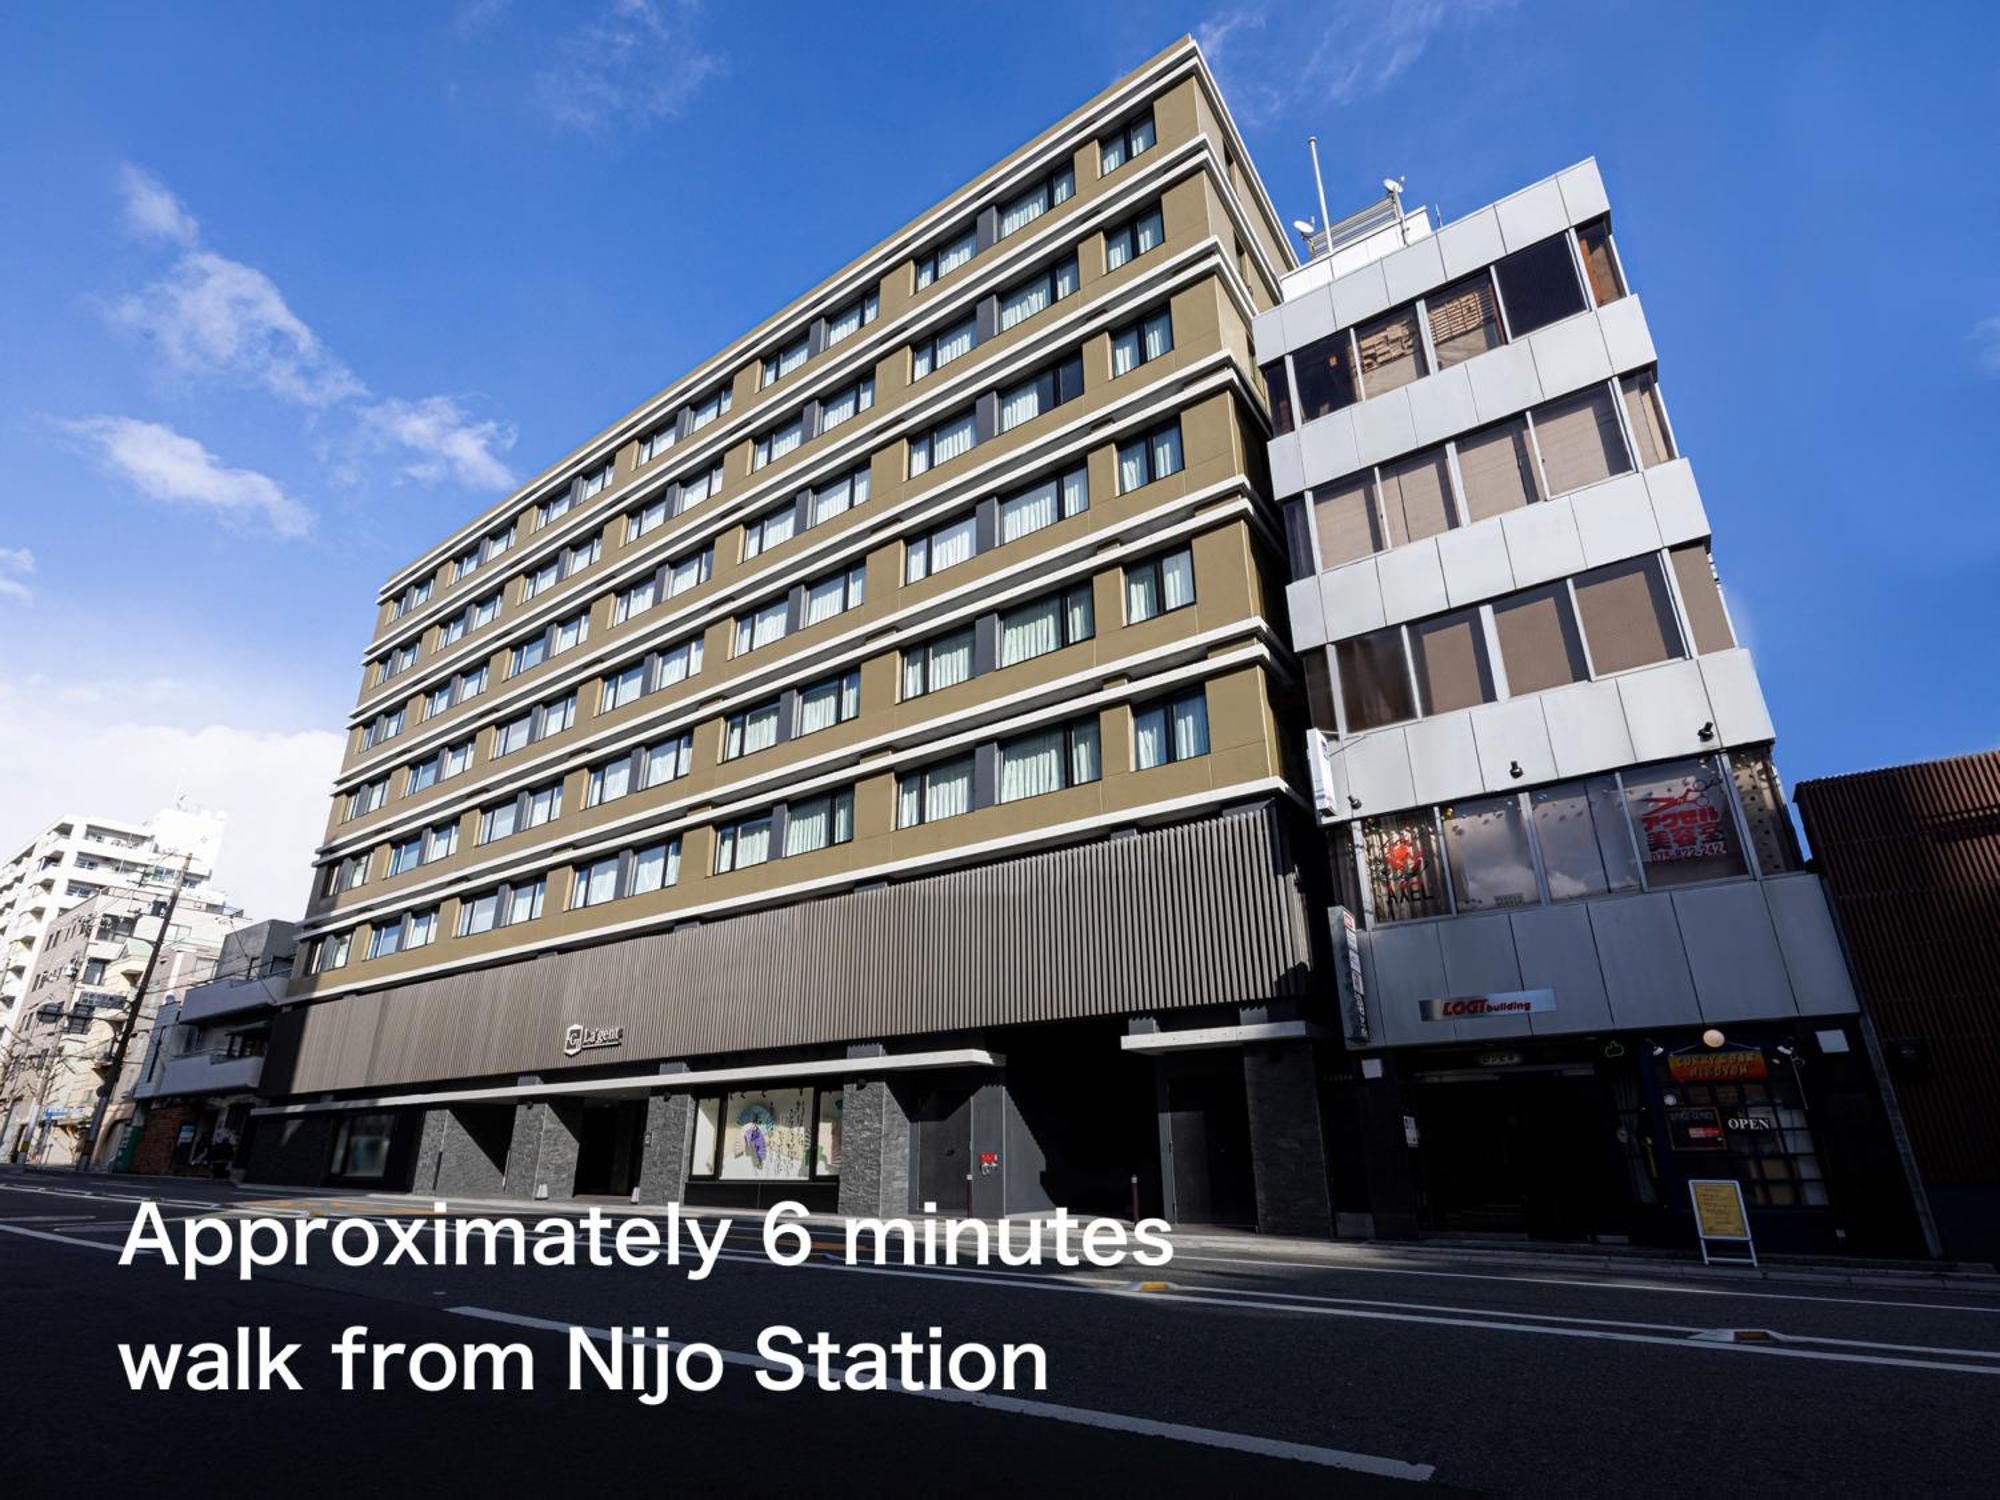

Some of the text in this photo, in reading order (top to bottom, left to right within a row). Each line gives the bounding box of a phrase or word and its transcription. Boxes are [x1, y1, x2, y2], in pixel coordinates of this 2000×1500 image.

[1642, 805, 1720, 832] アクセル
[1386, 879, 1434, 904] AXEL
[1486, 1001, 1531, 1013] building
[1727, 1117, 1770, 1130] OPEN
